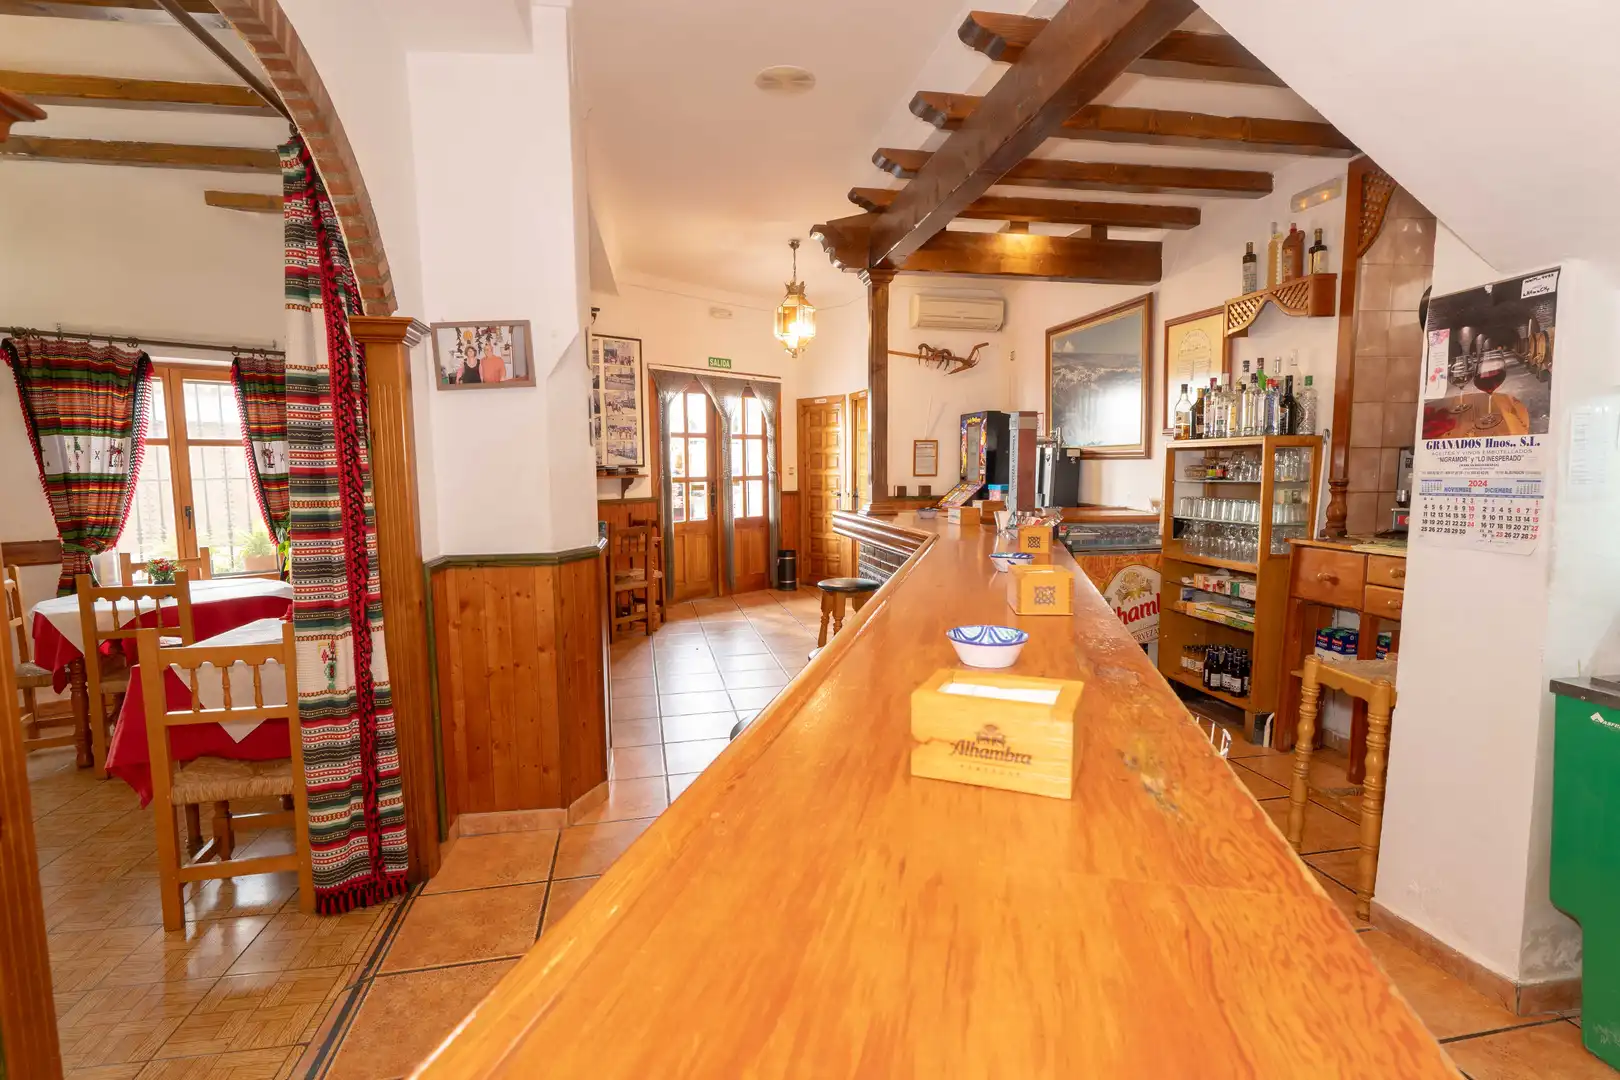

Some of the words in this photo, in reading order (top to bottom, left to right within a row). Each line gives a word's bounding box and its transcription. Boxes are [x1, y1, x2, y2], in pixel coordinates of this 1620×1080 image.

[710, 358, 730, 367] SALIDA
[1426, 439, 1480, 450] GRANADOS
[1520, 436, 1540, 446] S.L.
[1114, 592, 1160, 625] ham
[1133, 627, 1160, 641] ERVEZA
[949, 740, 1032, 764] Alhambra
